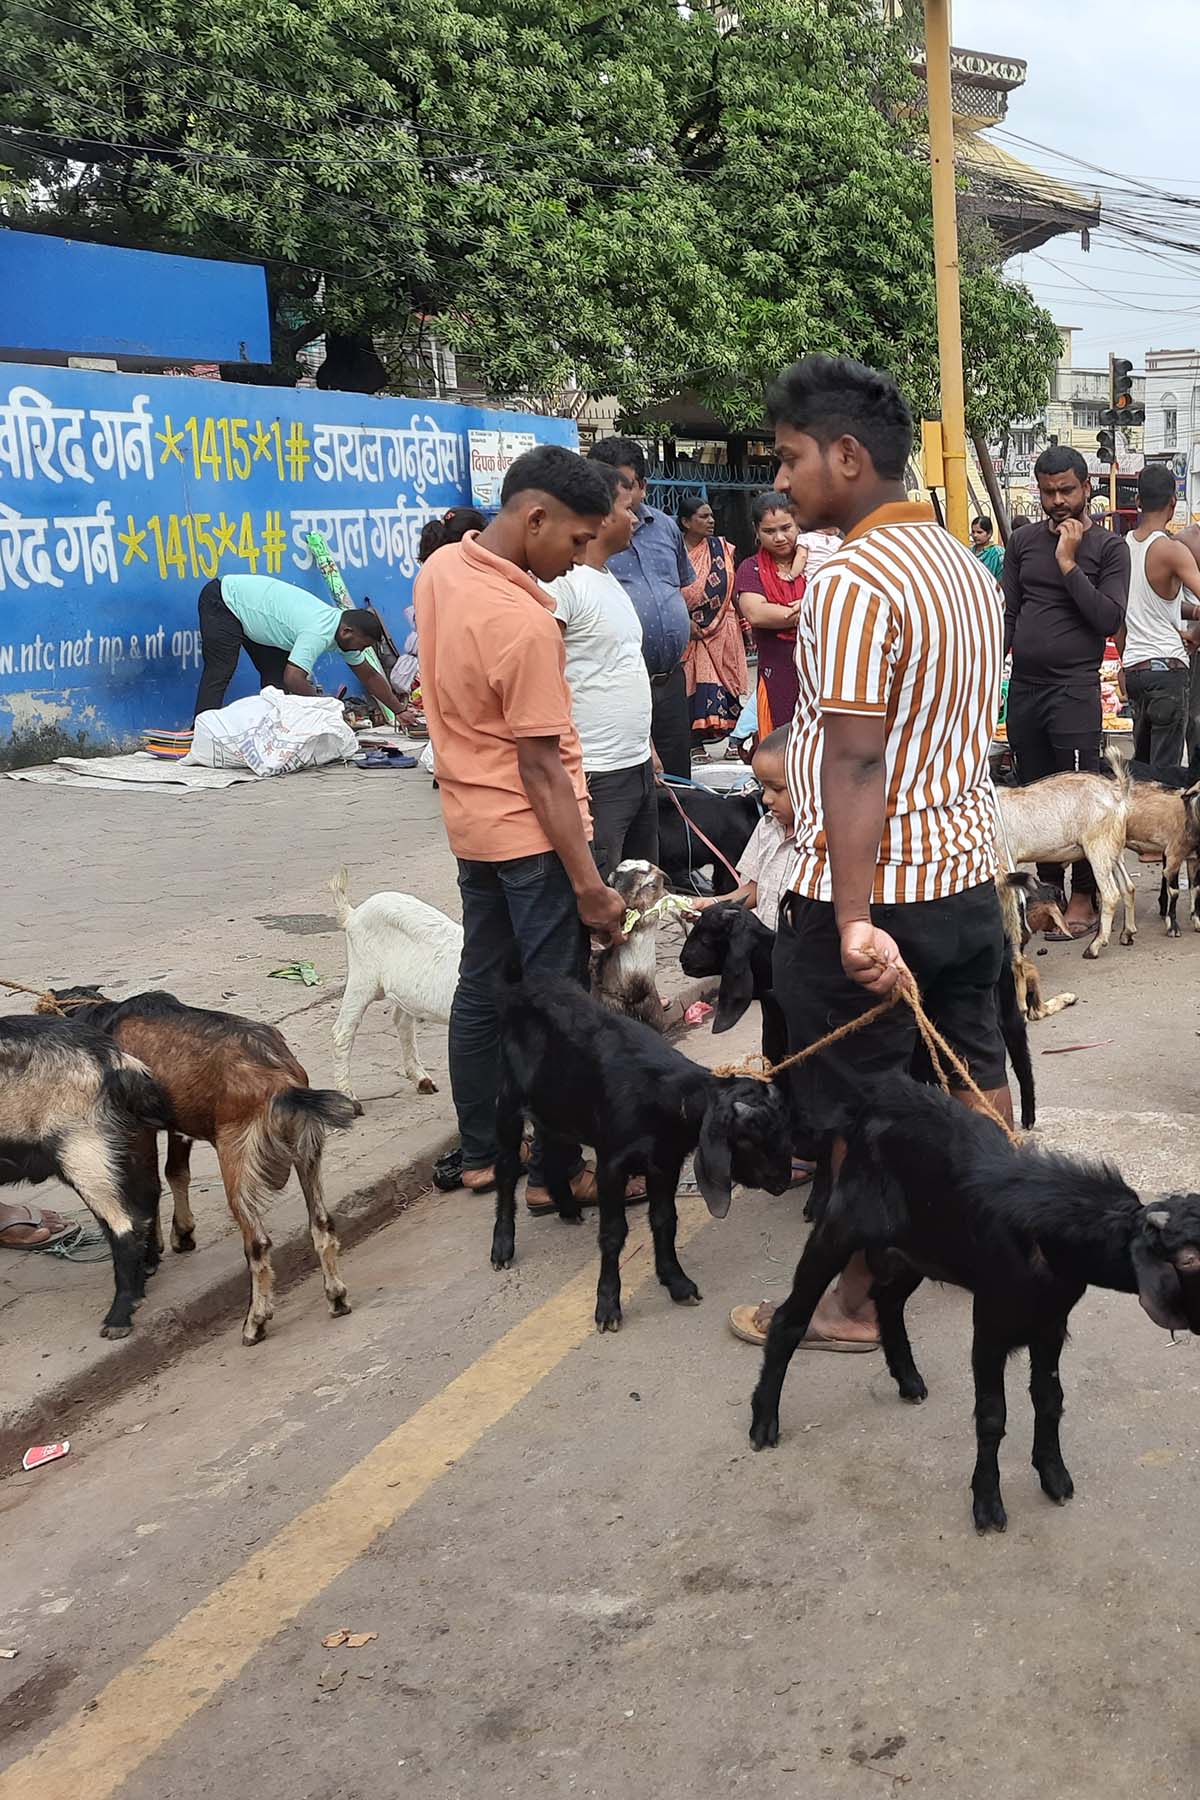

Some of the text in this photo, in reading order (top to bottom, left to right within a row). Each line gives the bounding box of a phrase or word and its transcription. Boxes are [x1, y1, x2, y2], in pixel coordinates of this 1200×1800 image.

[89, 394, 154, 480] गर्न
[313, 423, 386, 483] डायल
[0, 501, 64, 591] रिद
[53, 500, 118, 585] गर्न
[130, 634, 142, 659] &
[145, 624, 166, 660] nt
